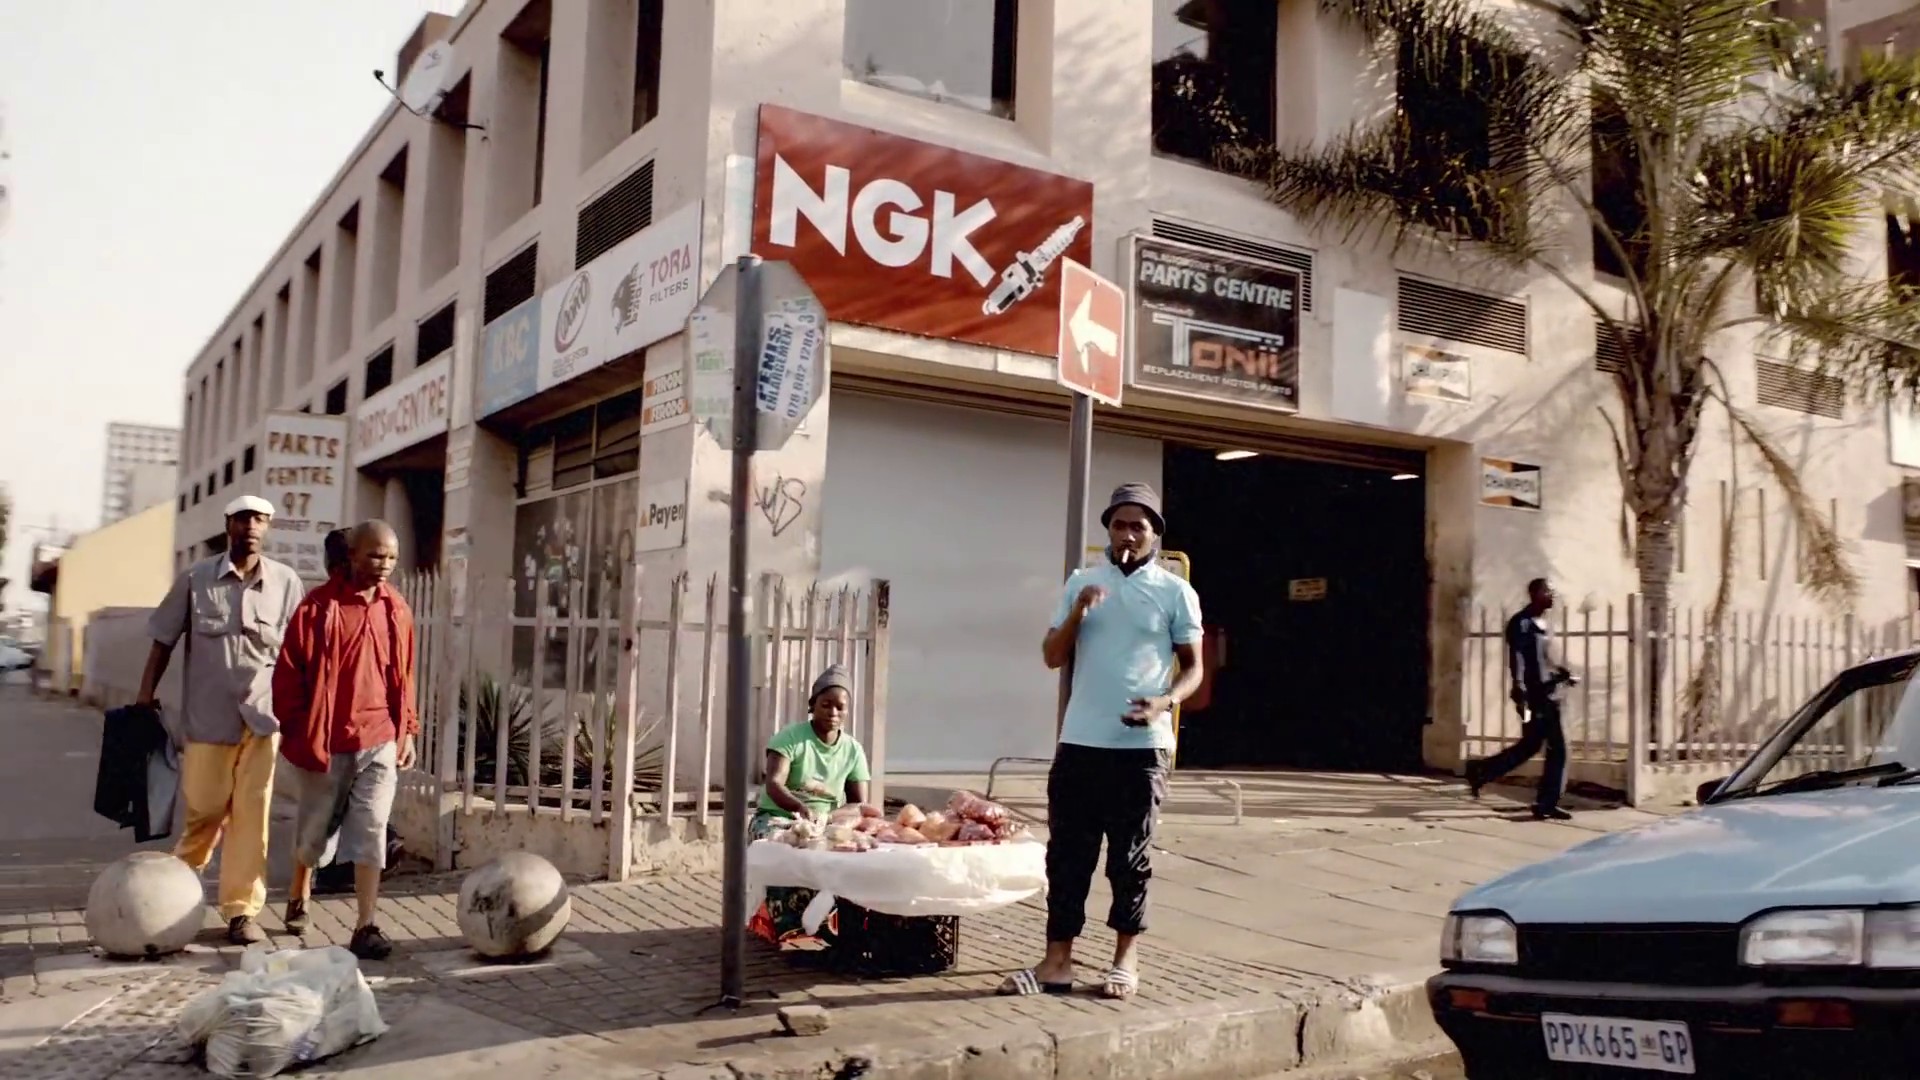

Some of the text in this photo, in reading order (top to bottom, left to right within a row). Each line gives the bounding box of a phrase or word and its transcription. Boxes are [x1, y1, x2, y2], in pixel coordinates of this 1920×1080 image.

[769, 152, 998, 288] NGK
[649, 243, 691, 288] TORA
[1140, 261, 1207, 294] PARTS
[1214, 276, 1293, 310] CENTRE
[649, 277, 689, 304] FILTERS
[492, 314, 531, 374] KBC
[1142, 364, 1292, 395] REPLACEMENT MOTOR PARTS
[395, 375, 446, 435] CENTRE
[269, 432, 340, 458] PARTS
[266, 467, 334, 486] CENTRE
[650, 502, 685, 529] Payen
[1546, 1021, 1689, 1066] PPK665 GP
